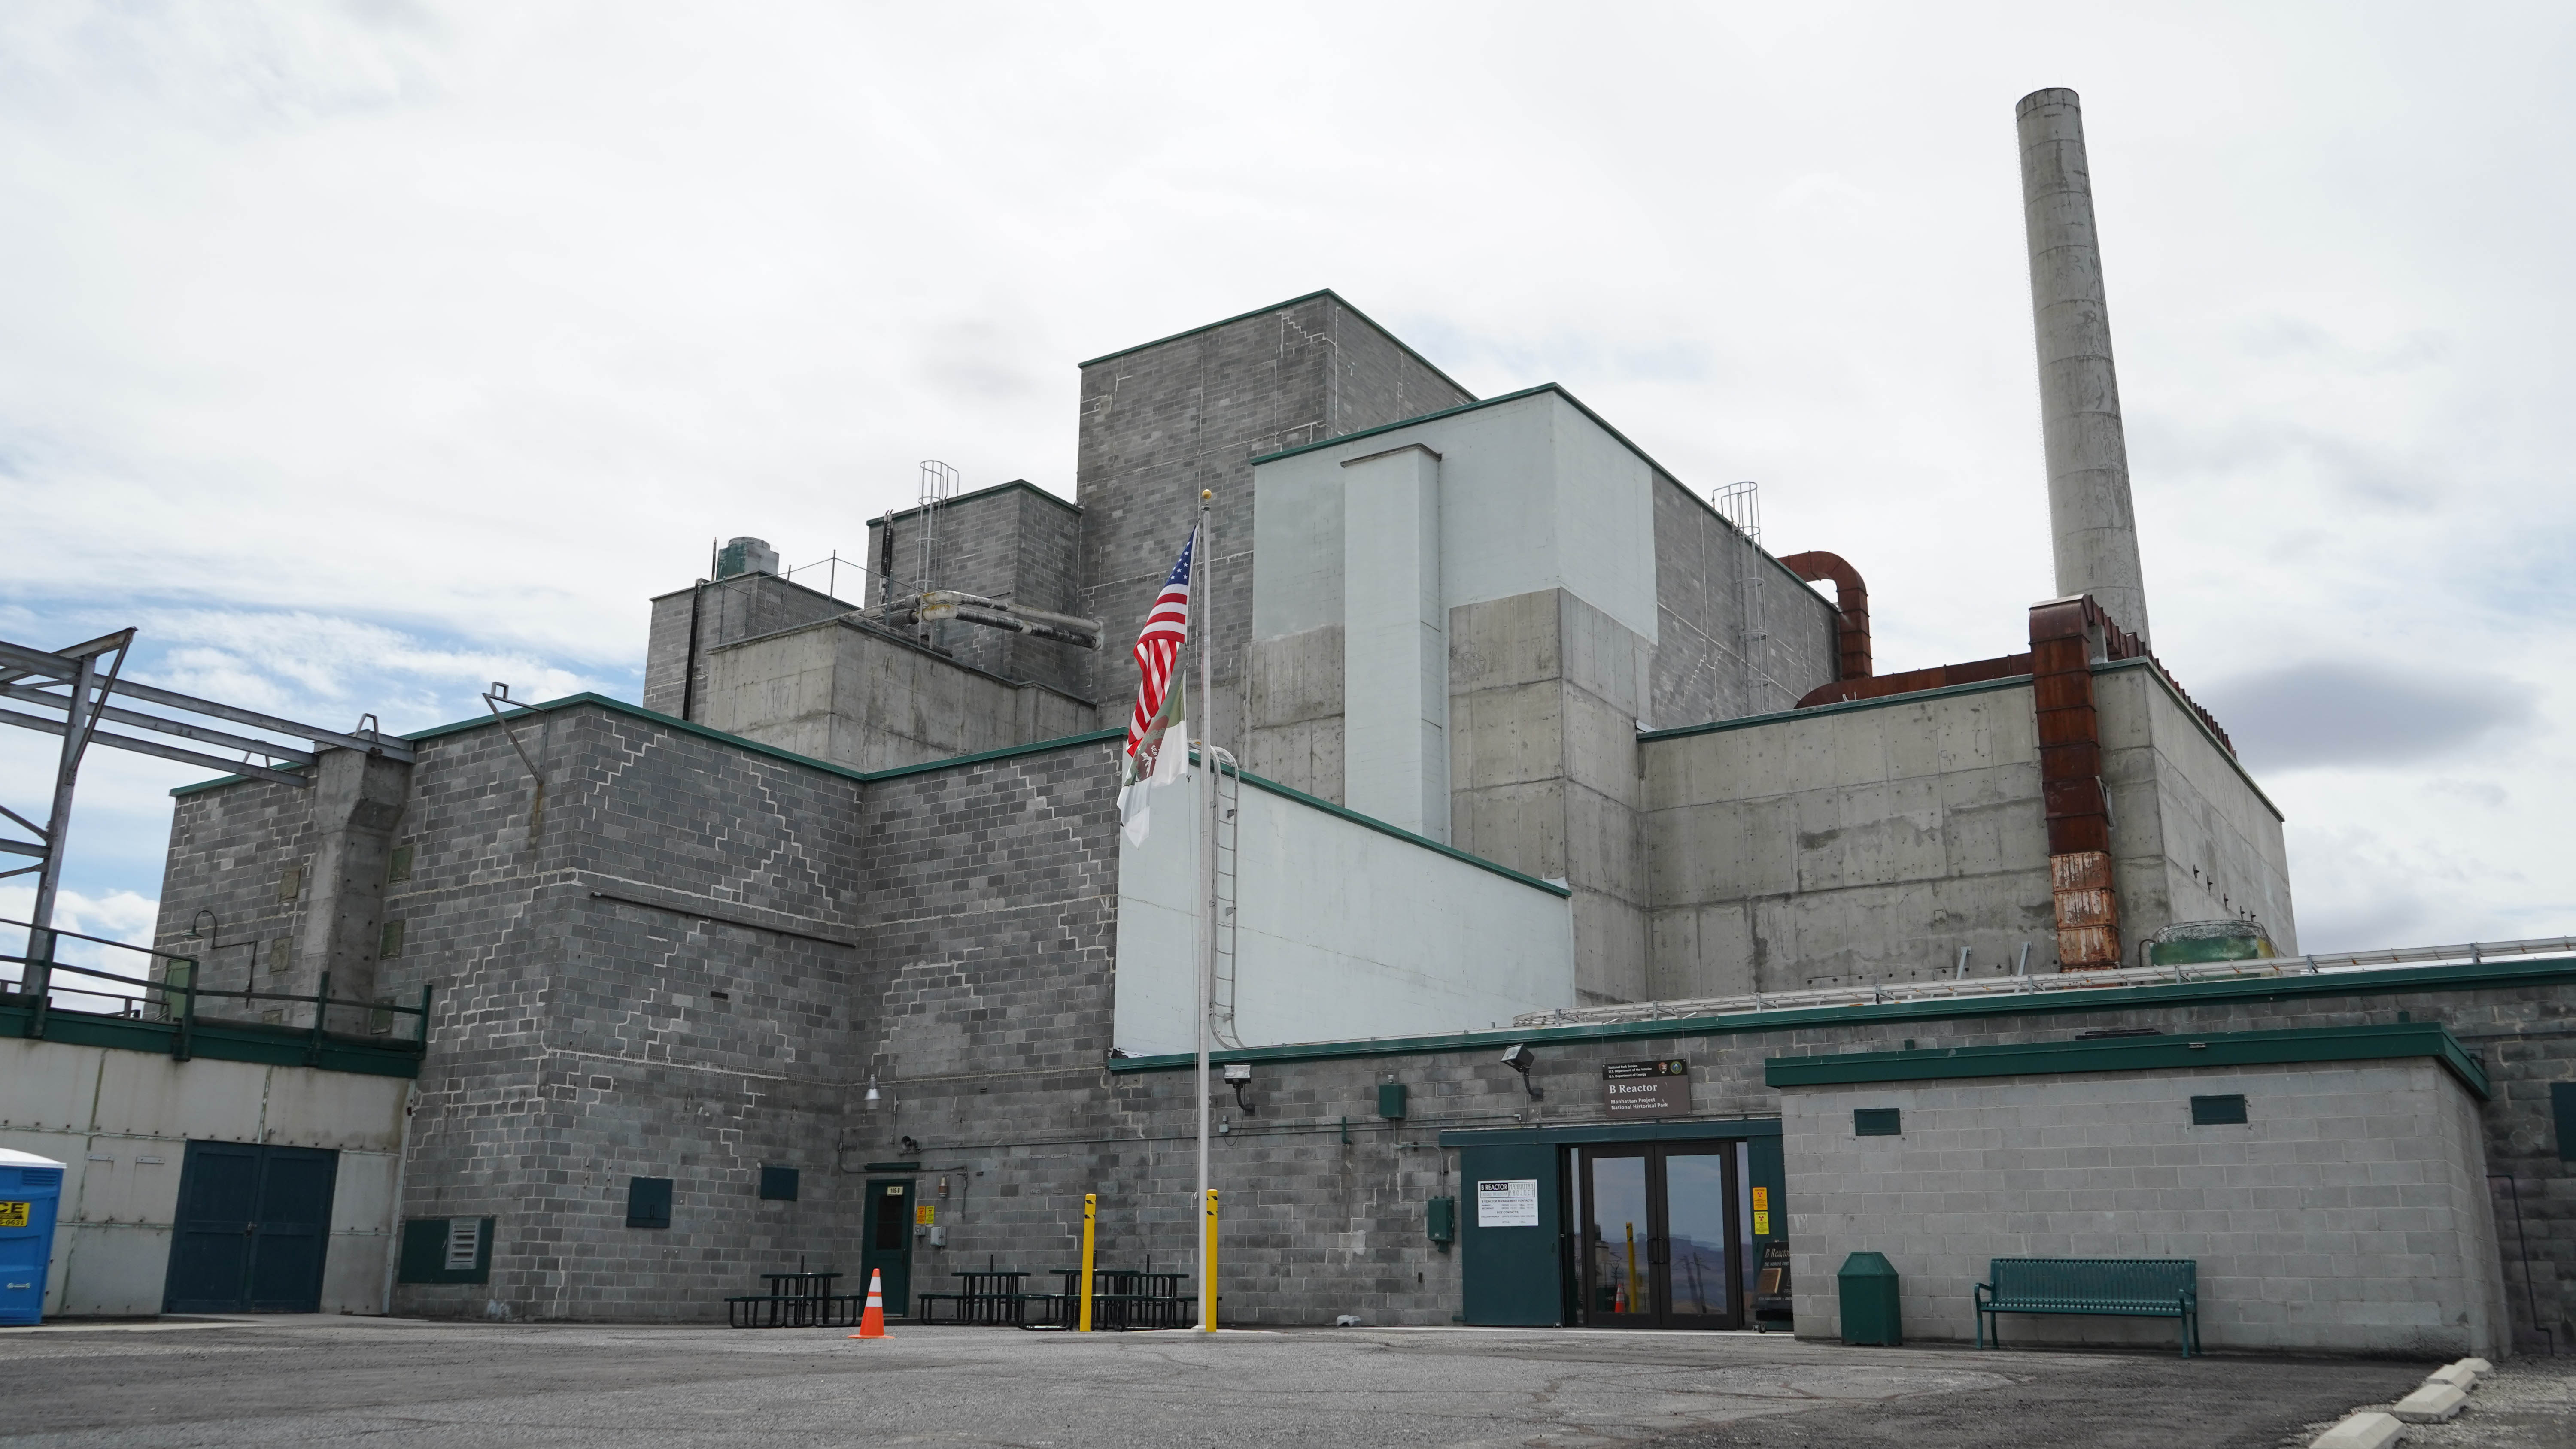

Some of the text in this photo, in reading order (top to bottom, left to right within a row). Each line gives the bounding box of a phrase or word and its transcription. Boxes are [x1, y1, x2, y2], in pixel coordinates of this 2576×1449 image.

[1609, 1084, 1657, 1094] B Reactor
[1765, 1248, 1770, 1258] B
